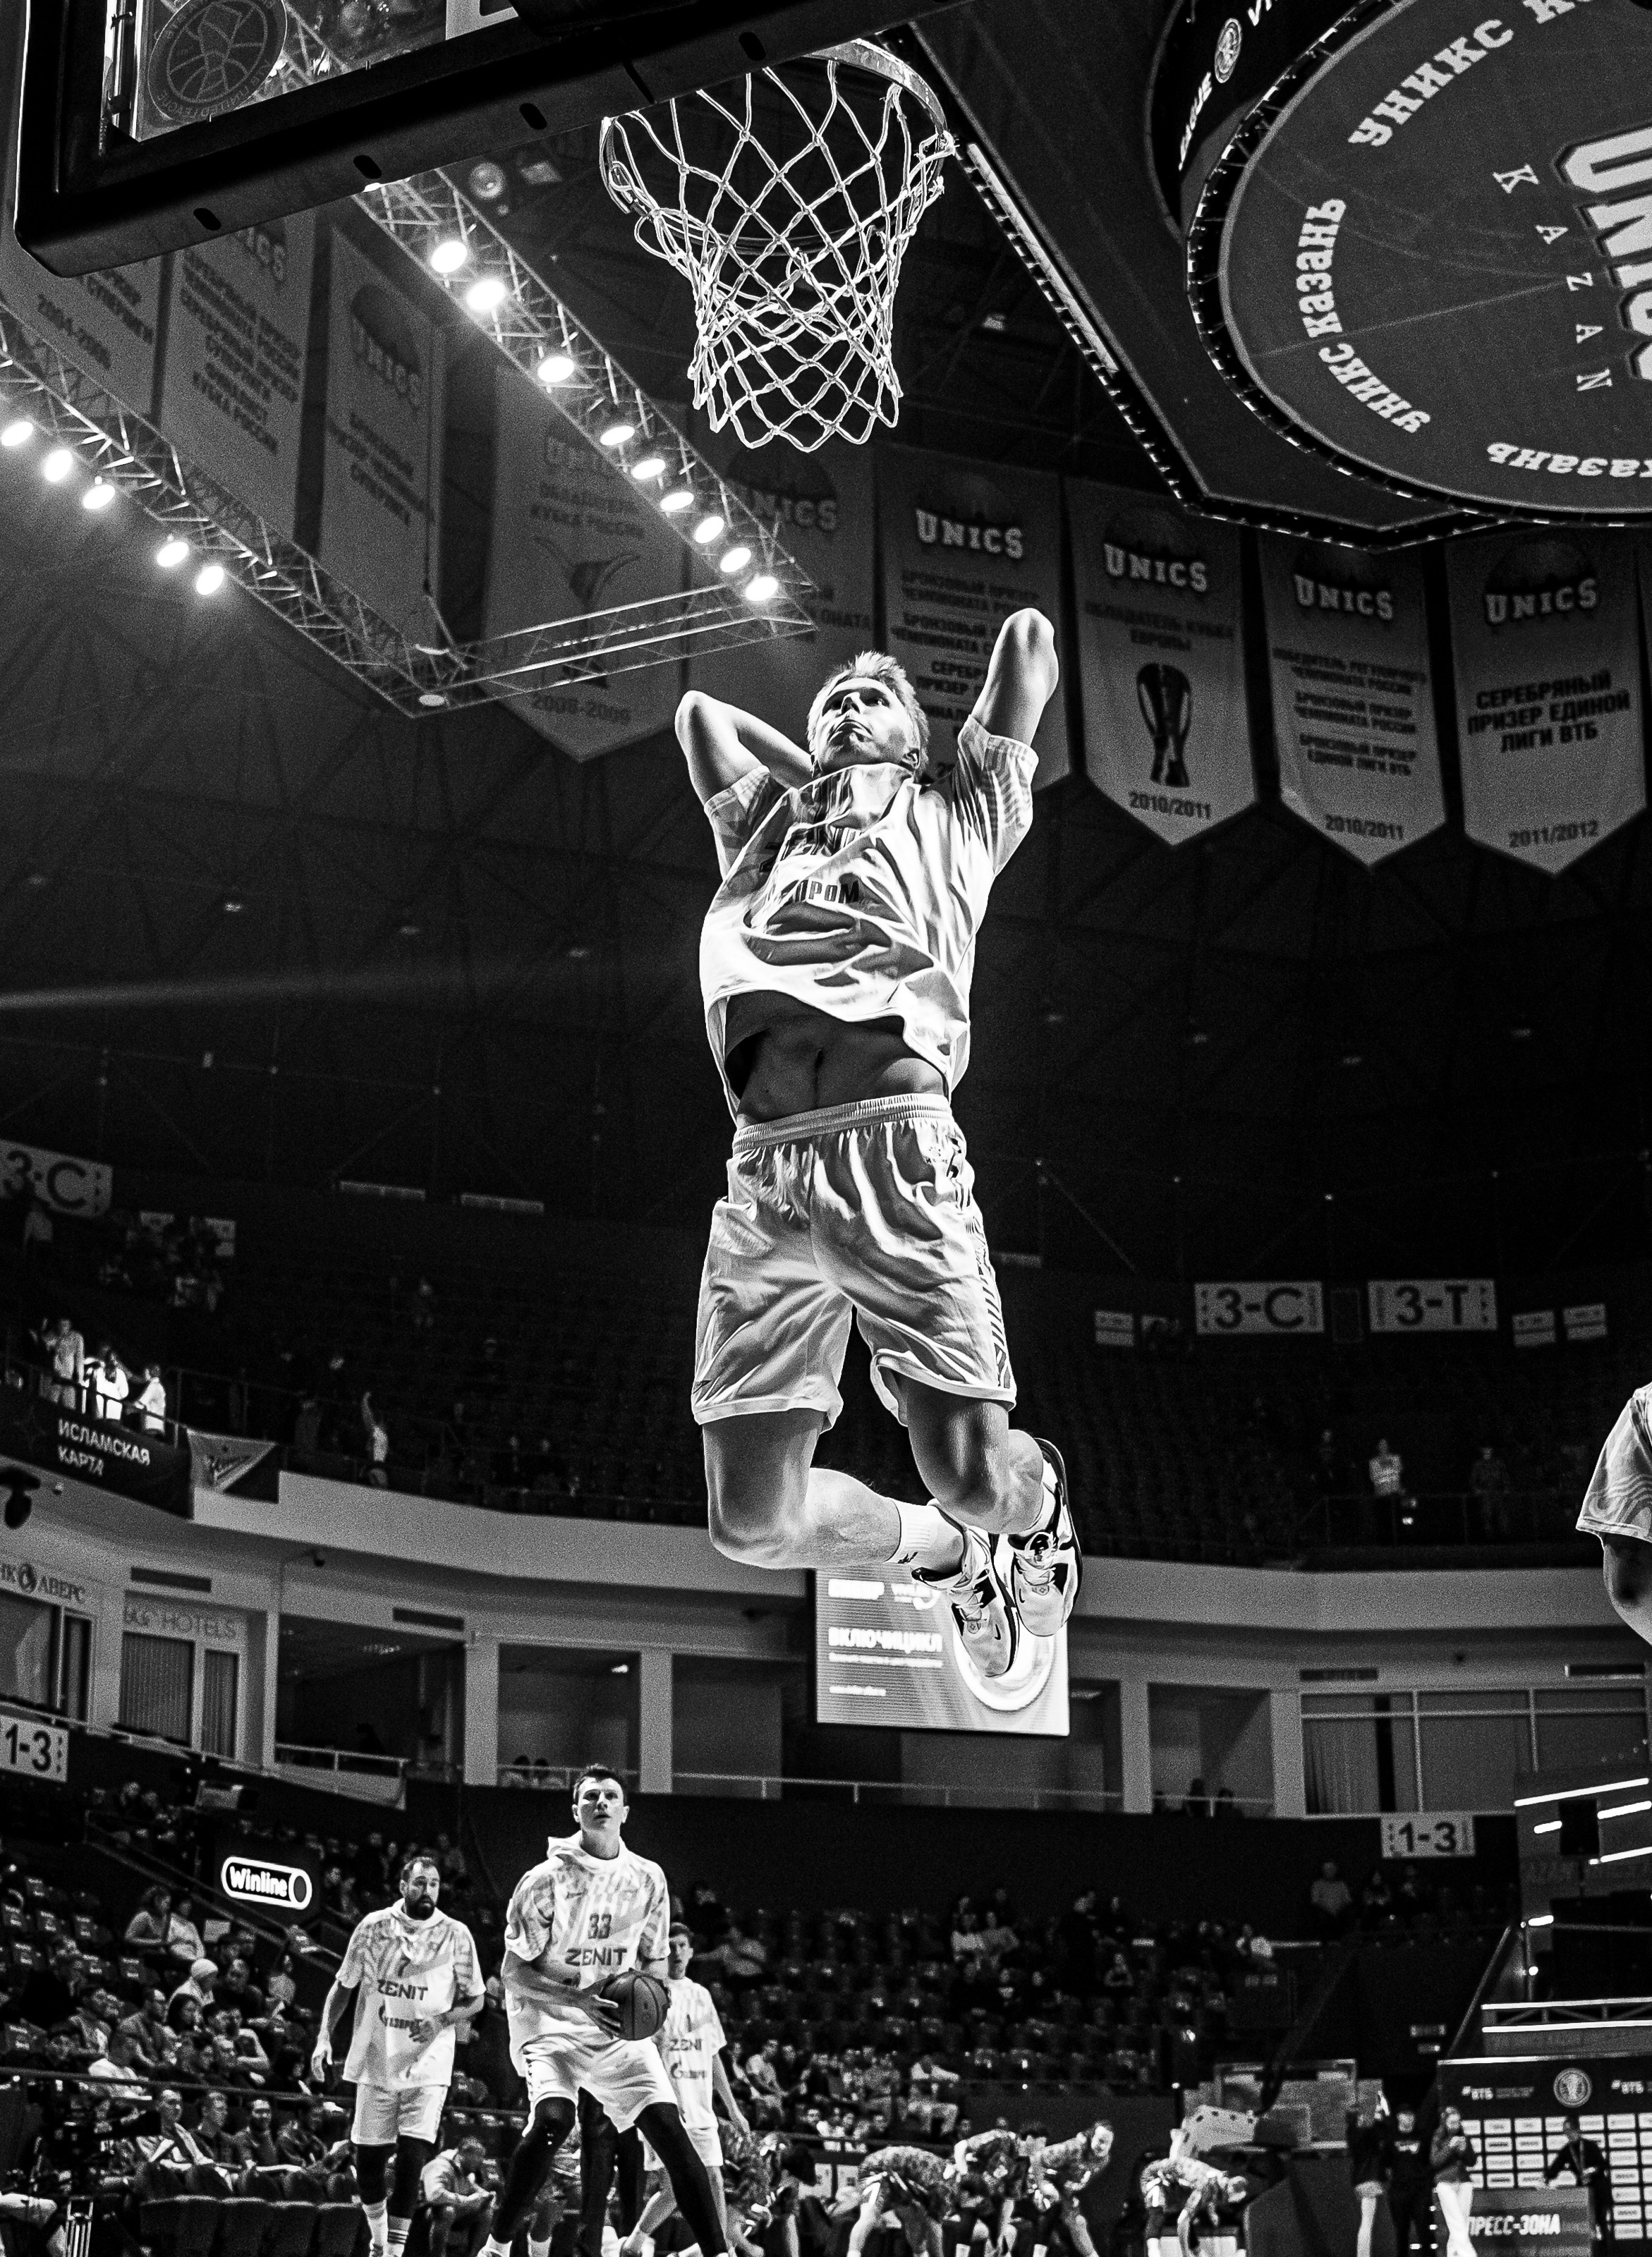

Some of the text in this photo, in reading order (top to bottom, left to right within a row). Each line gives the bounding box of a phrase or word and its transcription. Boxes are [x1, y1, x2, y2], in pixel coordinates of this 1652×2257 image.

[914, 506, 1026, 559] UNICS
[1102, 542, 1209, 592] UNICS
[1292, 573, 1395, 621] UNICS
[1484, 576, 1599, 625] UNICS
[1475, 667, 1612, 710] СЕРЕБРЯНЫЙ
[1467, 688, 1631, 736] ПРИЗЕР ЕДИНОЙ
[1500, 720, 1599, 755] ЛИГИ ВТБ
[1129, 790, 1213, 821] 2010/2011
[1325, 813, 1405, 841] 2010/2011
[1508, 819, 1601, 849] 2011/2012
[794, 878, 859, 904] ПРОМ
[58, 1418, 150, 1466] ИСЛАМСКАЯ
[58, 1444, 104, 1478] КАРТА
[37, 1576, 85, 1605] АВЕРС
[162, 1609, 237, 1639] HOTELS
[6, 1724, 51, 1772] 1-3
[1398, 1821, 1457, 1853] 1-3
[229, 1865, 288, 1898] Winline
[587, 1912, 612, 1940] 33
[397, 1955, 412, 1978] 7
[564, 1947, 628, 1966] ZENIT
[377, 1978, 429, 2002] ZENIT
[1468, 2213, 1561, 2237] ПРЕСС-ЗОНА
